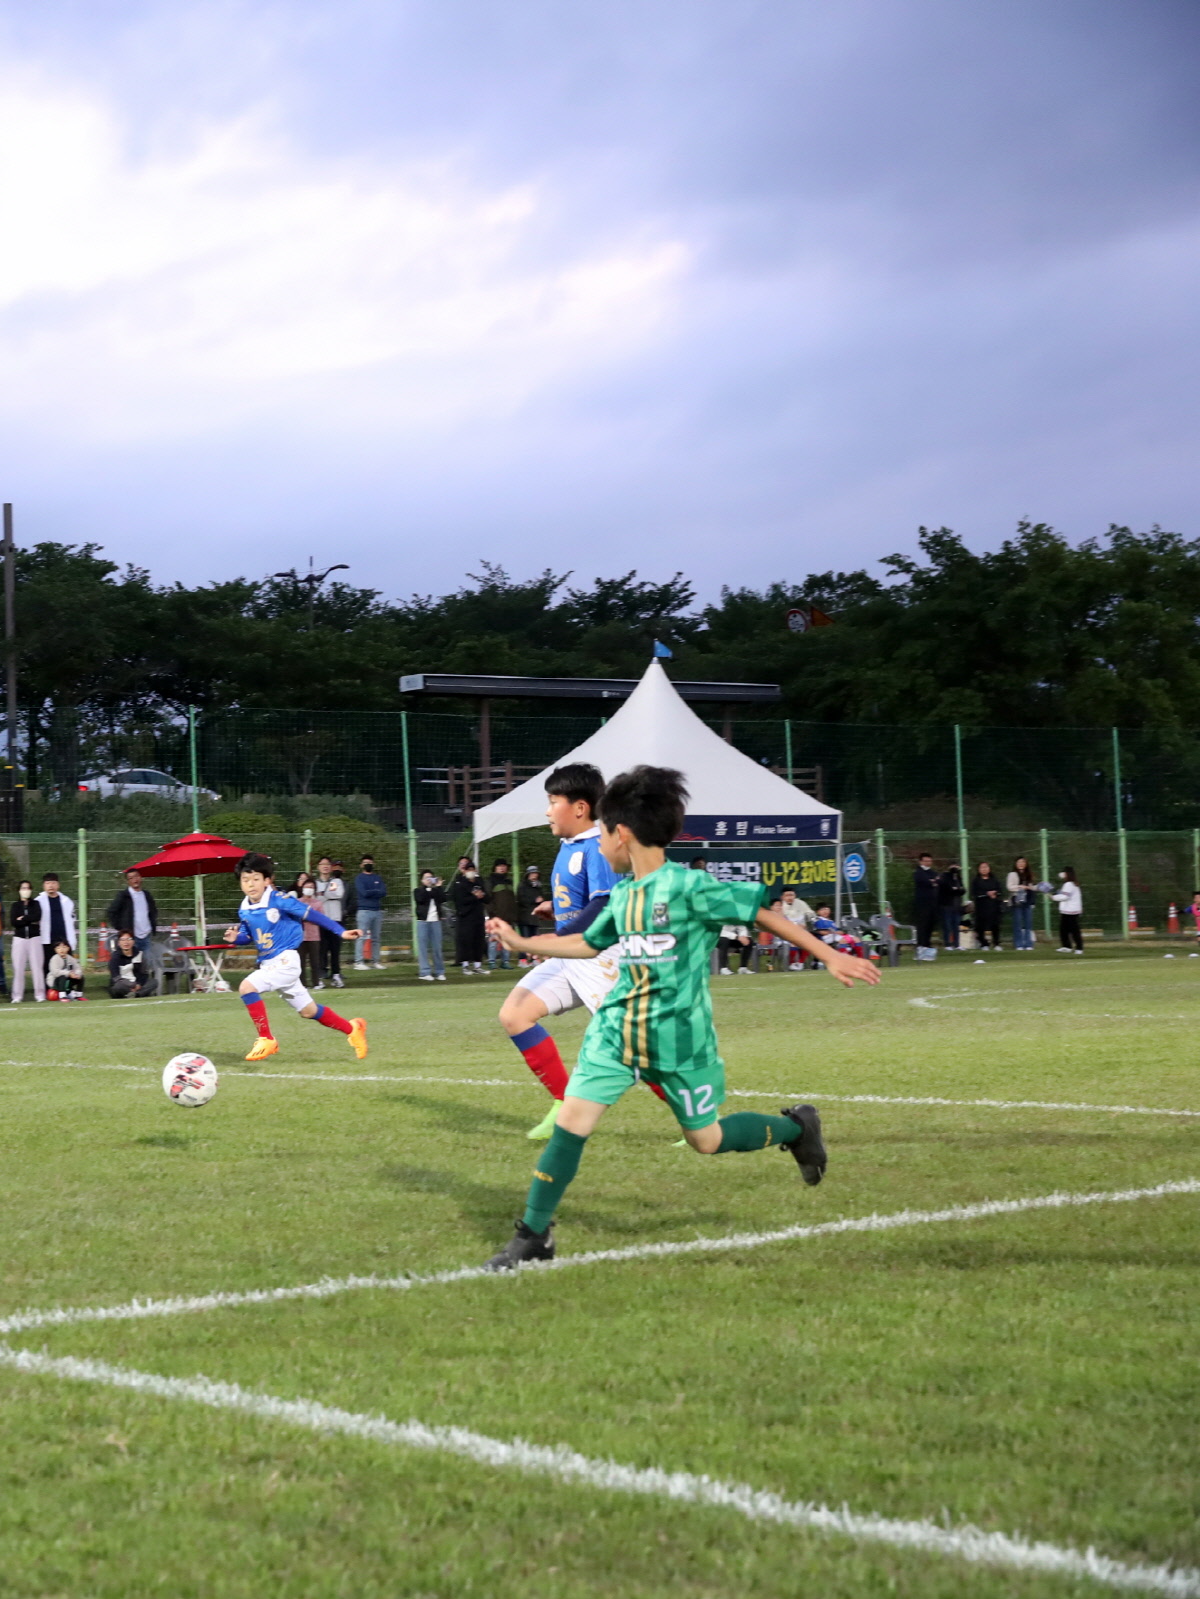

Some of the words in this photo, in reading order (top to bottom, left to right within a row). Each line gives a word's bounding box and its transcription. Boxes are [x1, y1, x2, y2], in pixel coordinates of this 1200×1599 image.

[715, 821, 728, 836] 홈
[736, 821, 748, 836] 팀
[753, 825, 776, 834] Home
[776, 824, 797, 834] Team
[678, 1084, 715, 1117] 12
